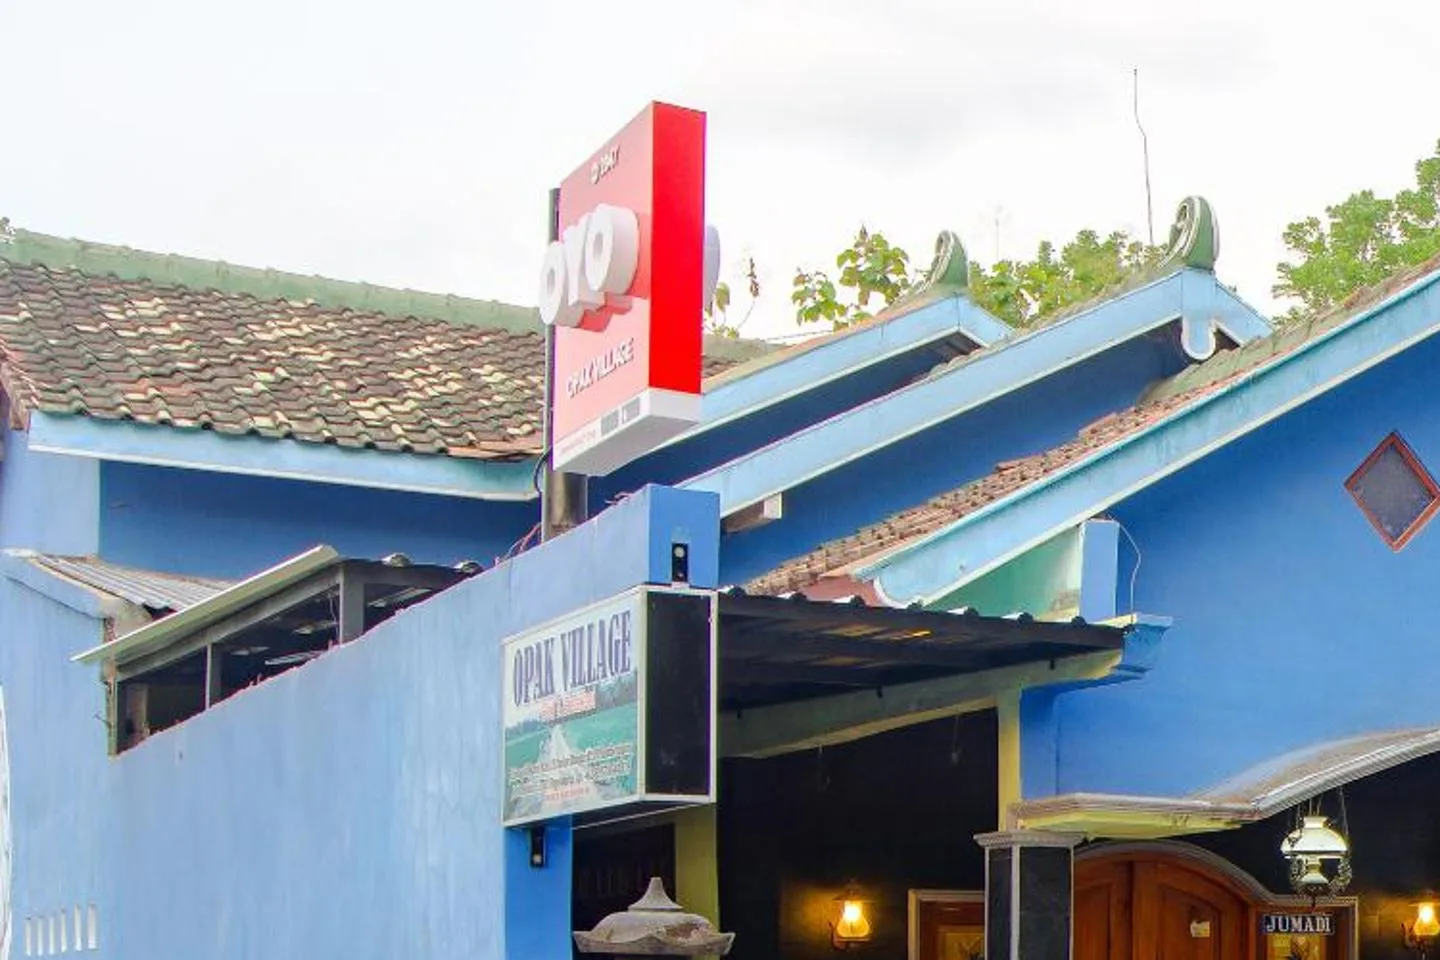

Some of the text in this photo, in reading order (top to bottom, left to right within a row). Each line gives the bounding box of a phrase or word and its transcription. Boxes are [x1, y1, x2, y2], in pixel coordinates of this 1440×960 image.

[540, 204, 632, 326] OYO
[513, 637, 555, 707] OPAK
[560, 610, 632, 692] VILLAGE
[1265, 915, 1331, 933] JUMADI
